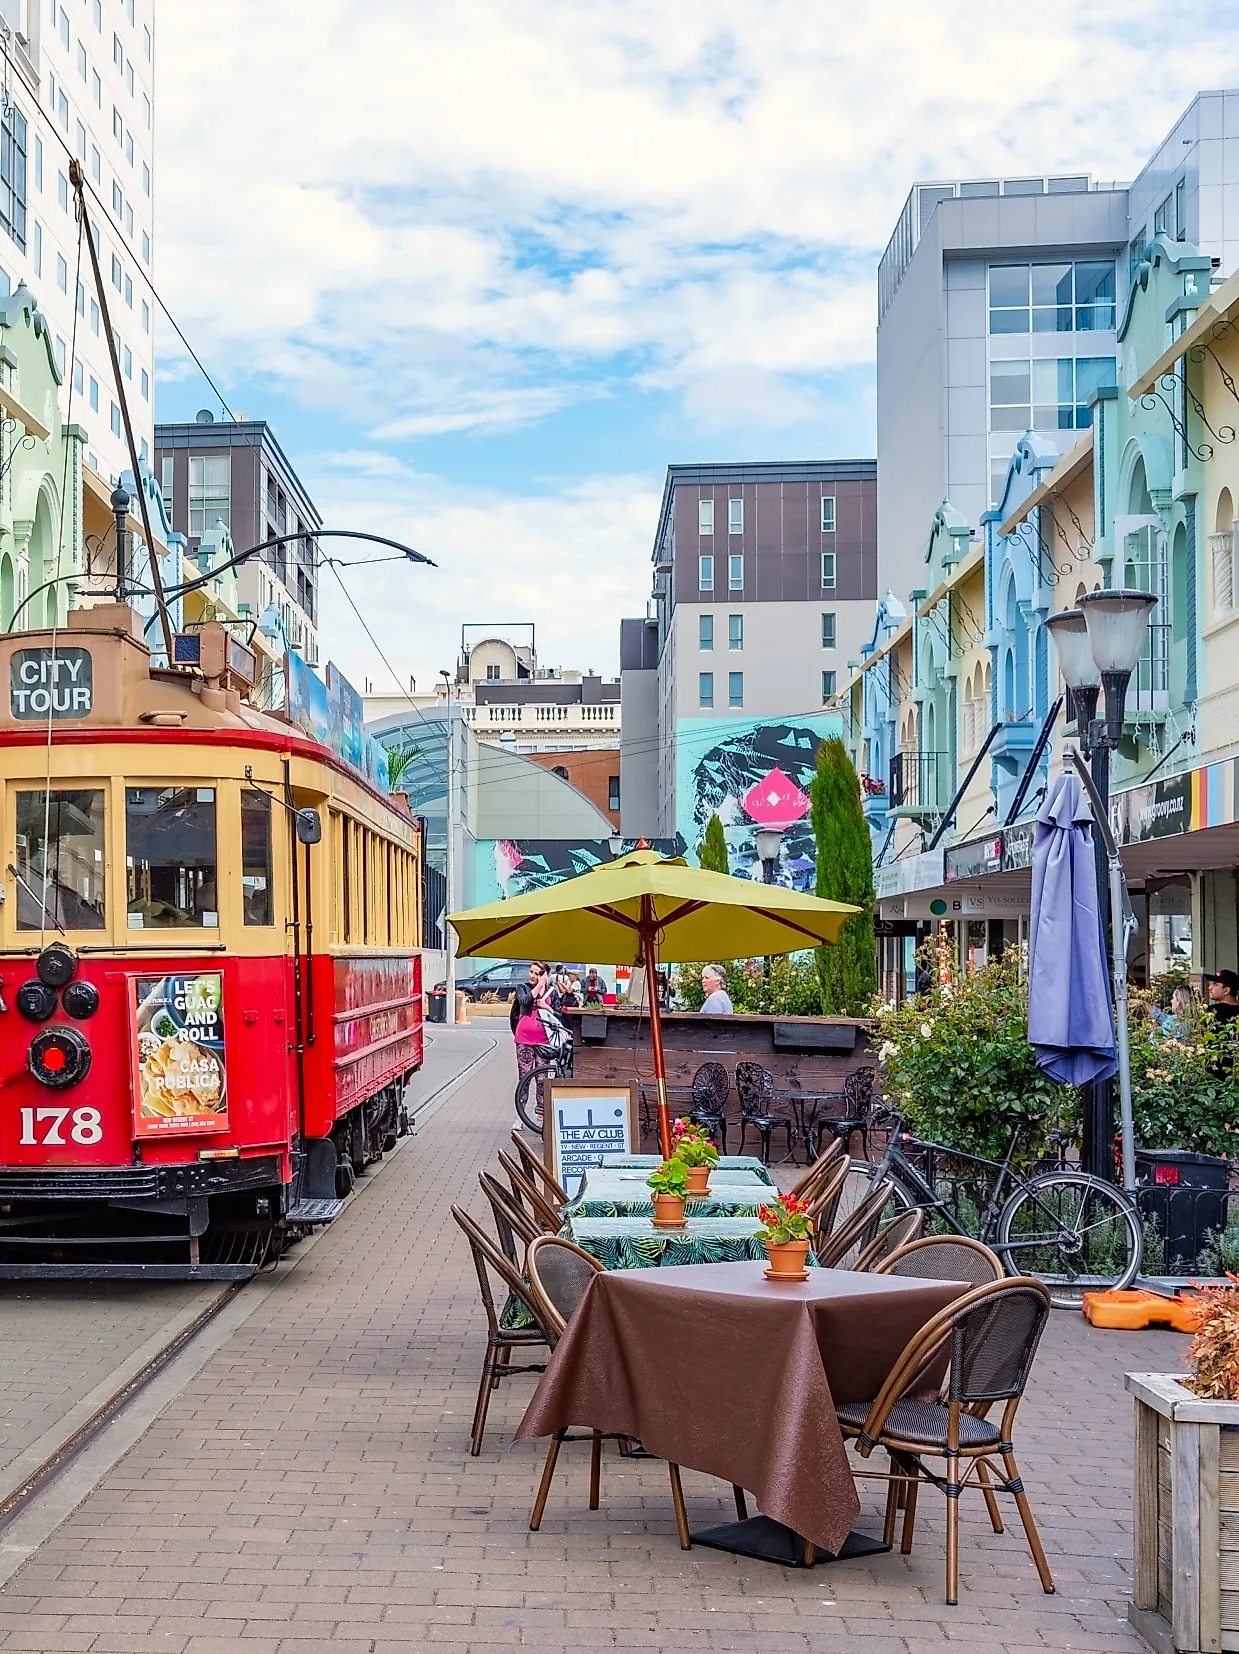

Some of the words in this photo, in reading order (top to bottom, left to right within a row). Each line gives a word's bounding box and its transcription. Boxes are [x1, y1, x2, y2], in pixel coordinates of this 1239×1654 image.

[20, 659, 83, 684] CITY
[12, 687, 92, 713] TOUR
[1140, 796, 1185, 822] www.groovy.co.nz
[969, 897, 983, 907] VS
[174, 980, 216, 995] LET'S
[174, 996, 217, 1010] GUAC
[184, 1012, 218, 1026] AND
[178, 1027, 219, 1041] ROLL
[179, 1058, 220, 1073] CASA
[19, 1106, 103, 1145] 178
[561, 1130, 580, 1139] THE
[582, 1129, 596, 1139] AV
[598, 1129, 625, 1139] CLUB
[561, 1154, 593, 1162] ARCADE
